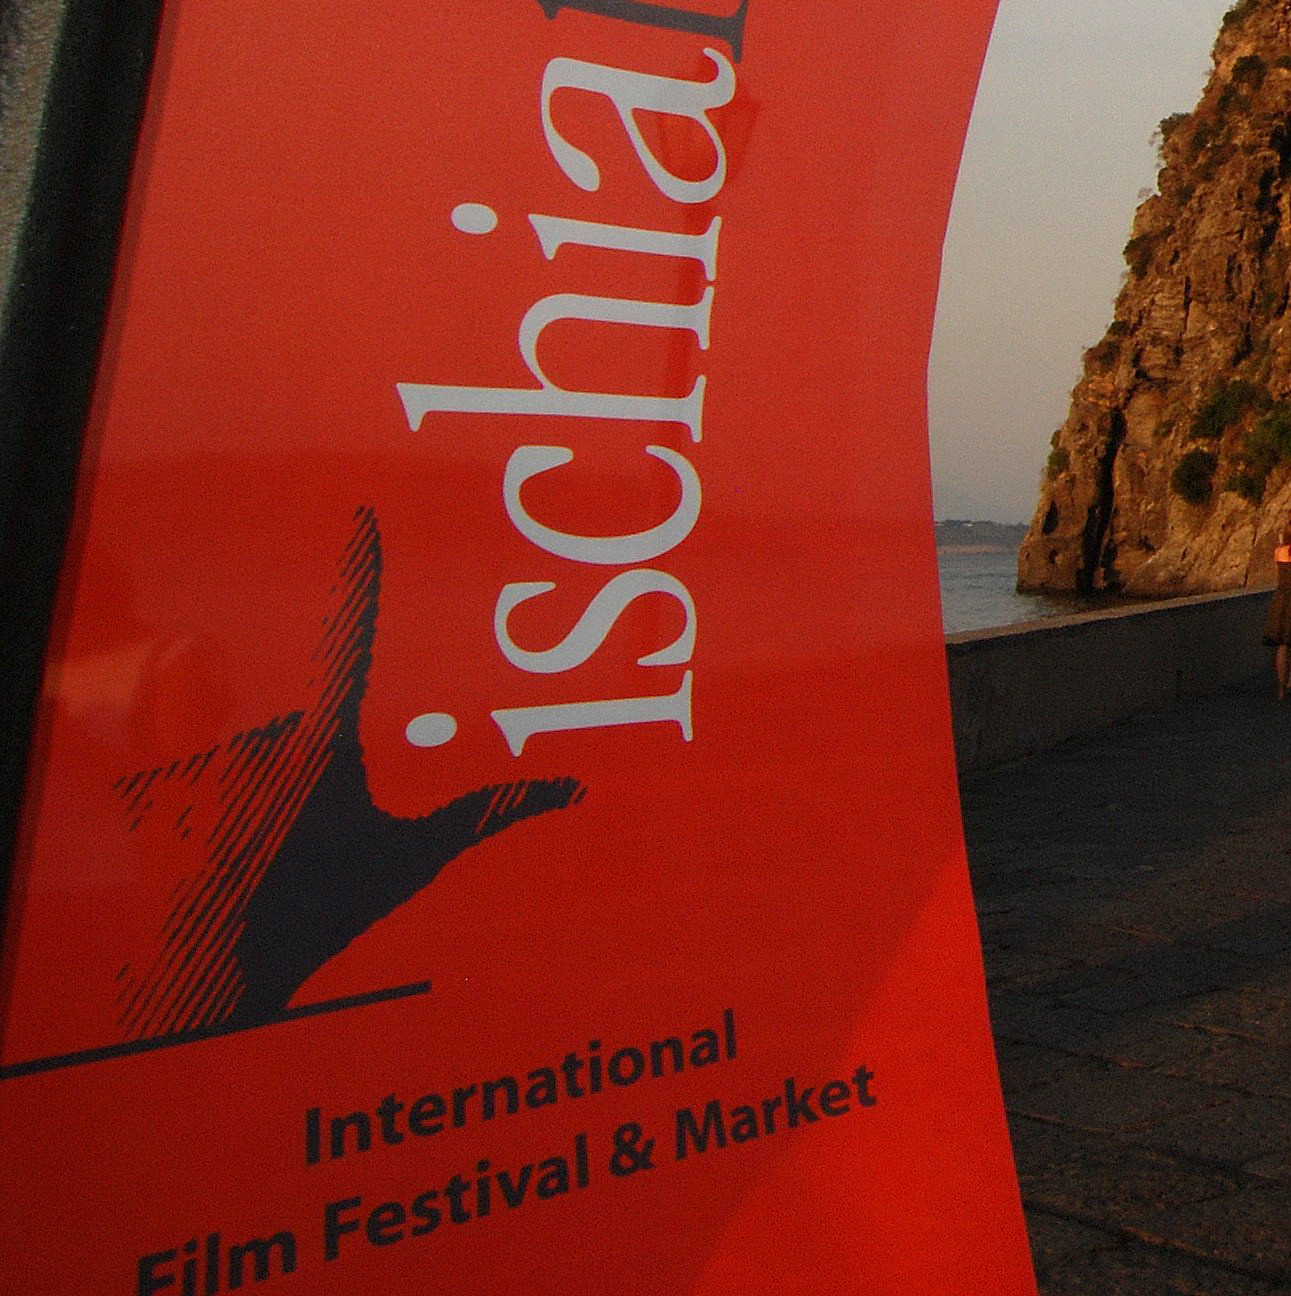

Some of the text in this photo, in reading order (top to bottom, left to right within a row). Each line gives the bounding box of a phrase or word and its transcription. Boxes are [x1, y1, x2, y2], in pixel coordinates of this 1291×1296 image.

[136, 1063, 878, 1296] Film Festival & Market
[304, 1009, 739, 1166] International
